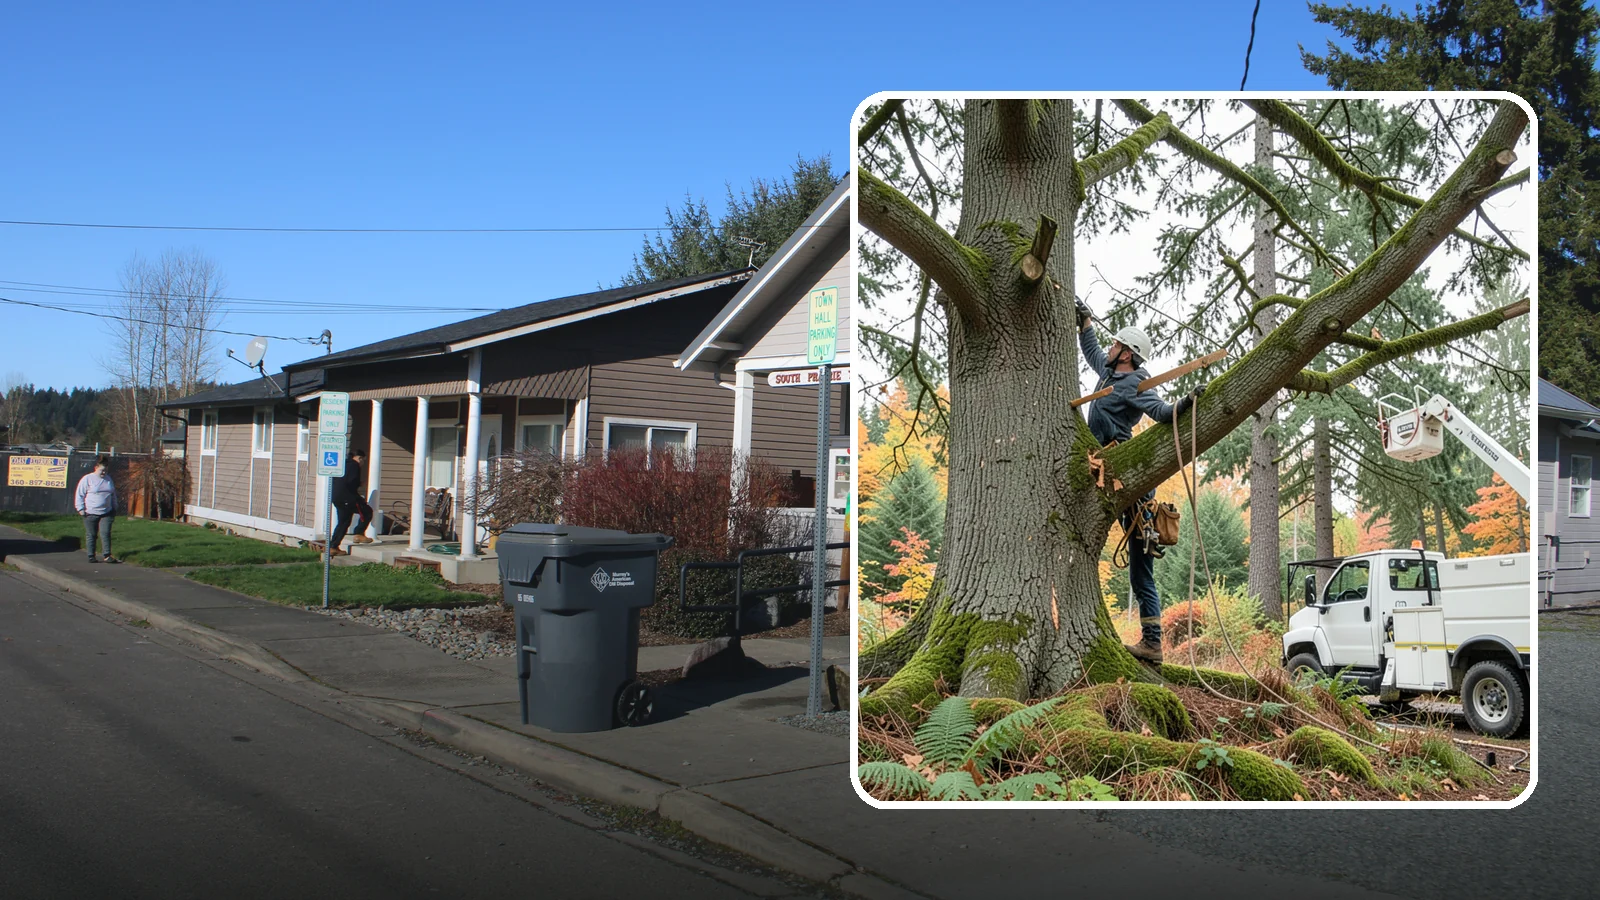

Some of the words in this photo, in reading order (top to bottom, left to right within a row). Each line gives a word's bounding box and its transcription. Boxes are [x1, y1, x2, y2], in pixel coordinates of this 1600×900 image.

[815, 294, 833, 308] TOWN
[814, 311, 831, 325] HALL
[809, 326, 836, 341] PARKING
[813, 344, 831, 357] ONLY
[775, 373, 801, 385] SOUTH
[807, 370, 842, 382] PRIE
[325, 420, 340, 428] ONLY
[10, 479, 65, 487] 360-897-8625
